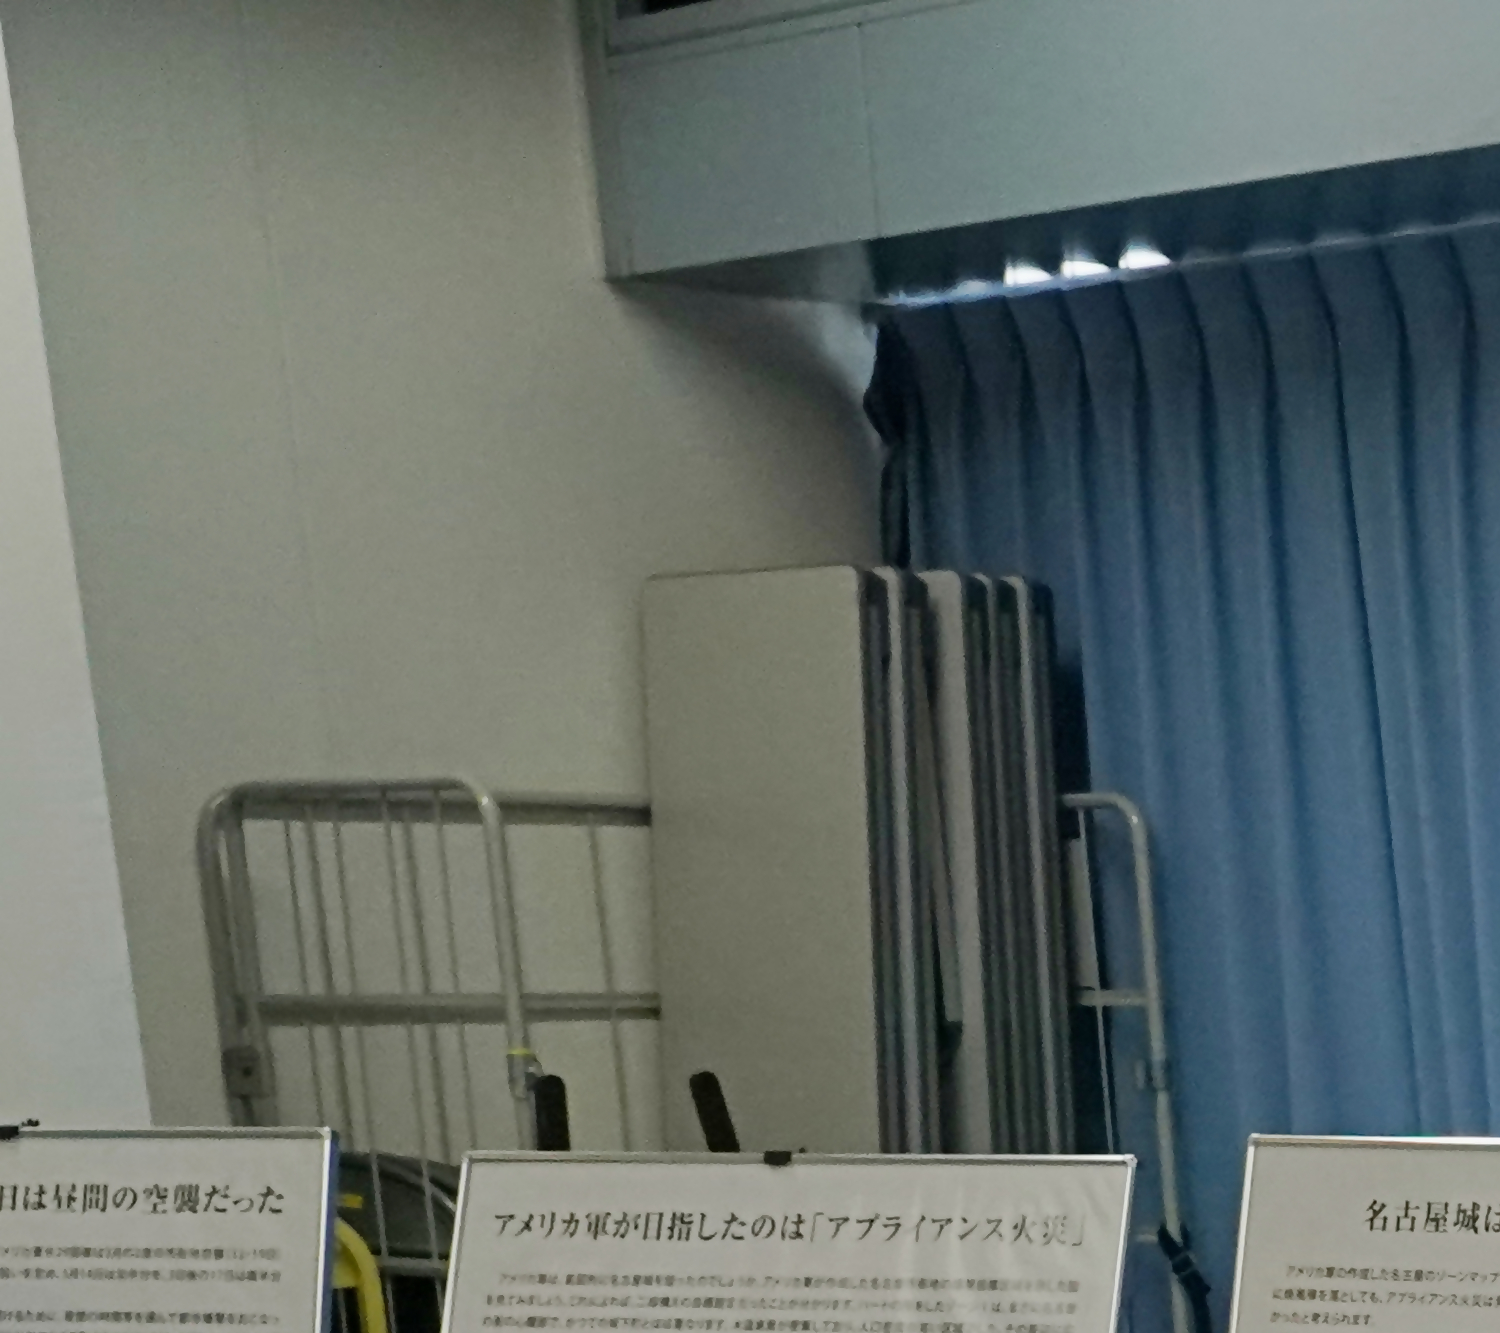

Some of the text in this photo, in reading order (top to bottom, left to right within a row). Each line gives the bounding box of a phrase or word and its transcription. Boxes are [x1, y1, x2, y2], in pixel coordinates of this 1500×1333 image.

[494, 1211, 1086, 1247] アメリカ軍が目指したのは「アプライアンス火災」
